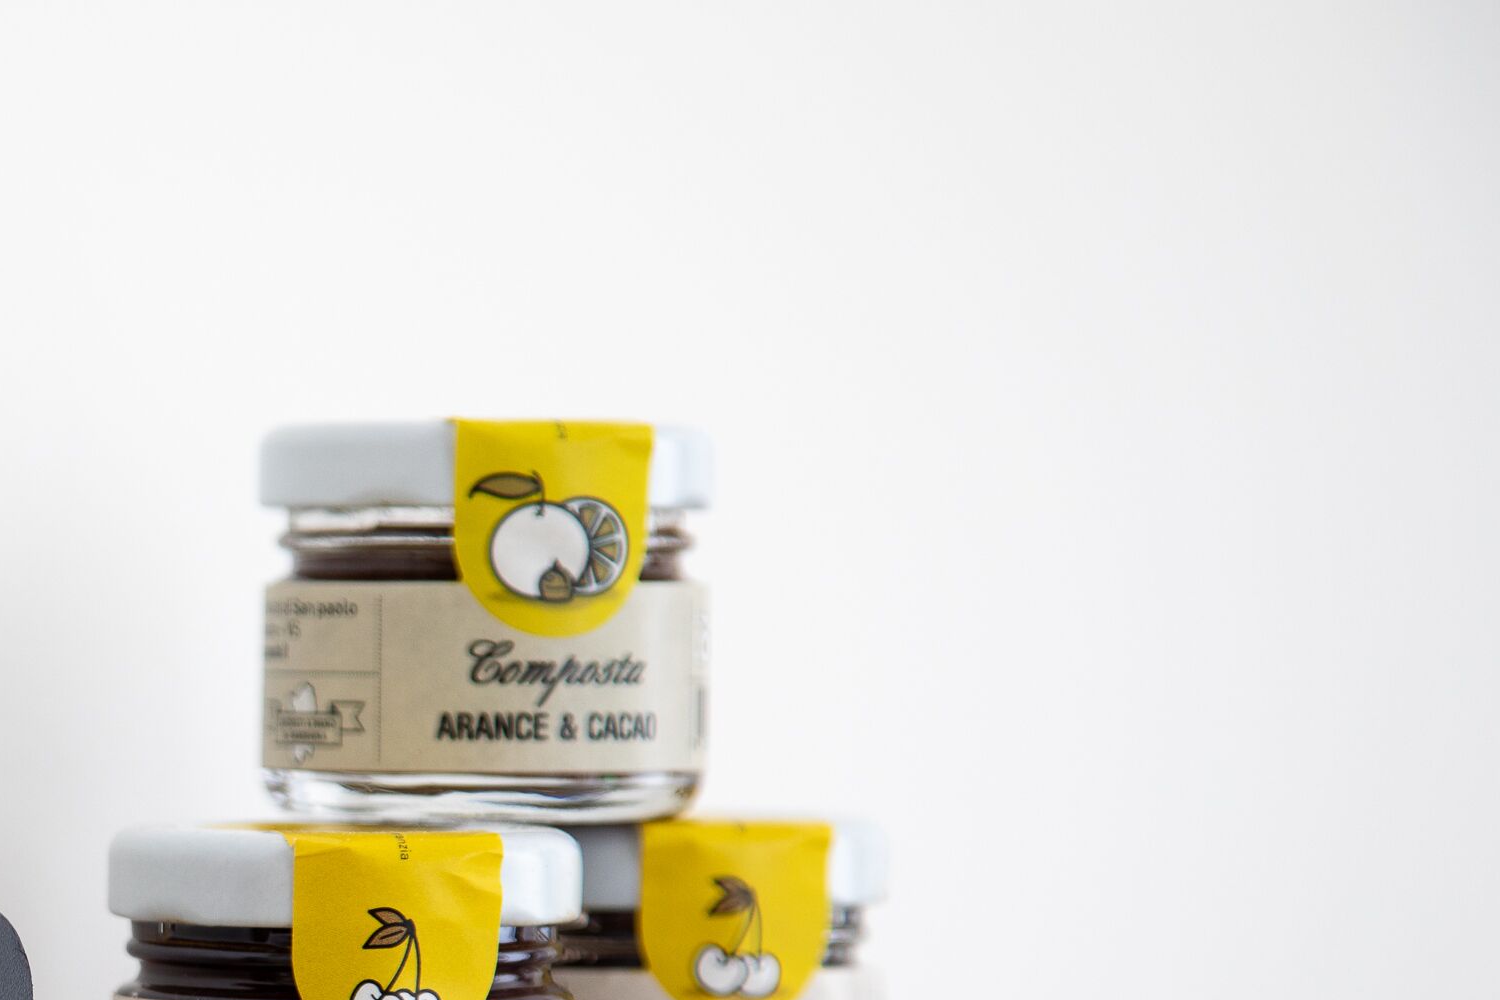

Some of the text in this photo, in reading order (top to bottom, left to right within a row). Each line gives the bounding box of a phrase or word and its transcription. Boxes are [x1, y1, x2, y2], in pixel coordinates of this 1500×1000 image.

[467, 638, 646, 707] Composta
[436, 712, 657, 741] ARANCE & CACAO
